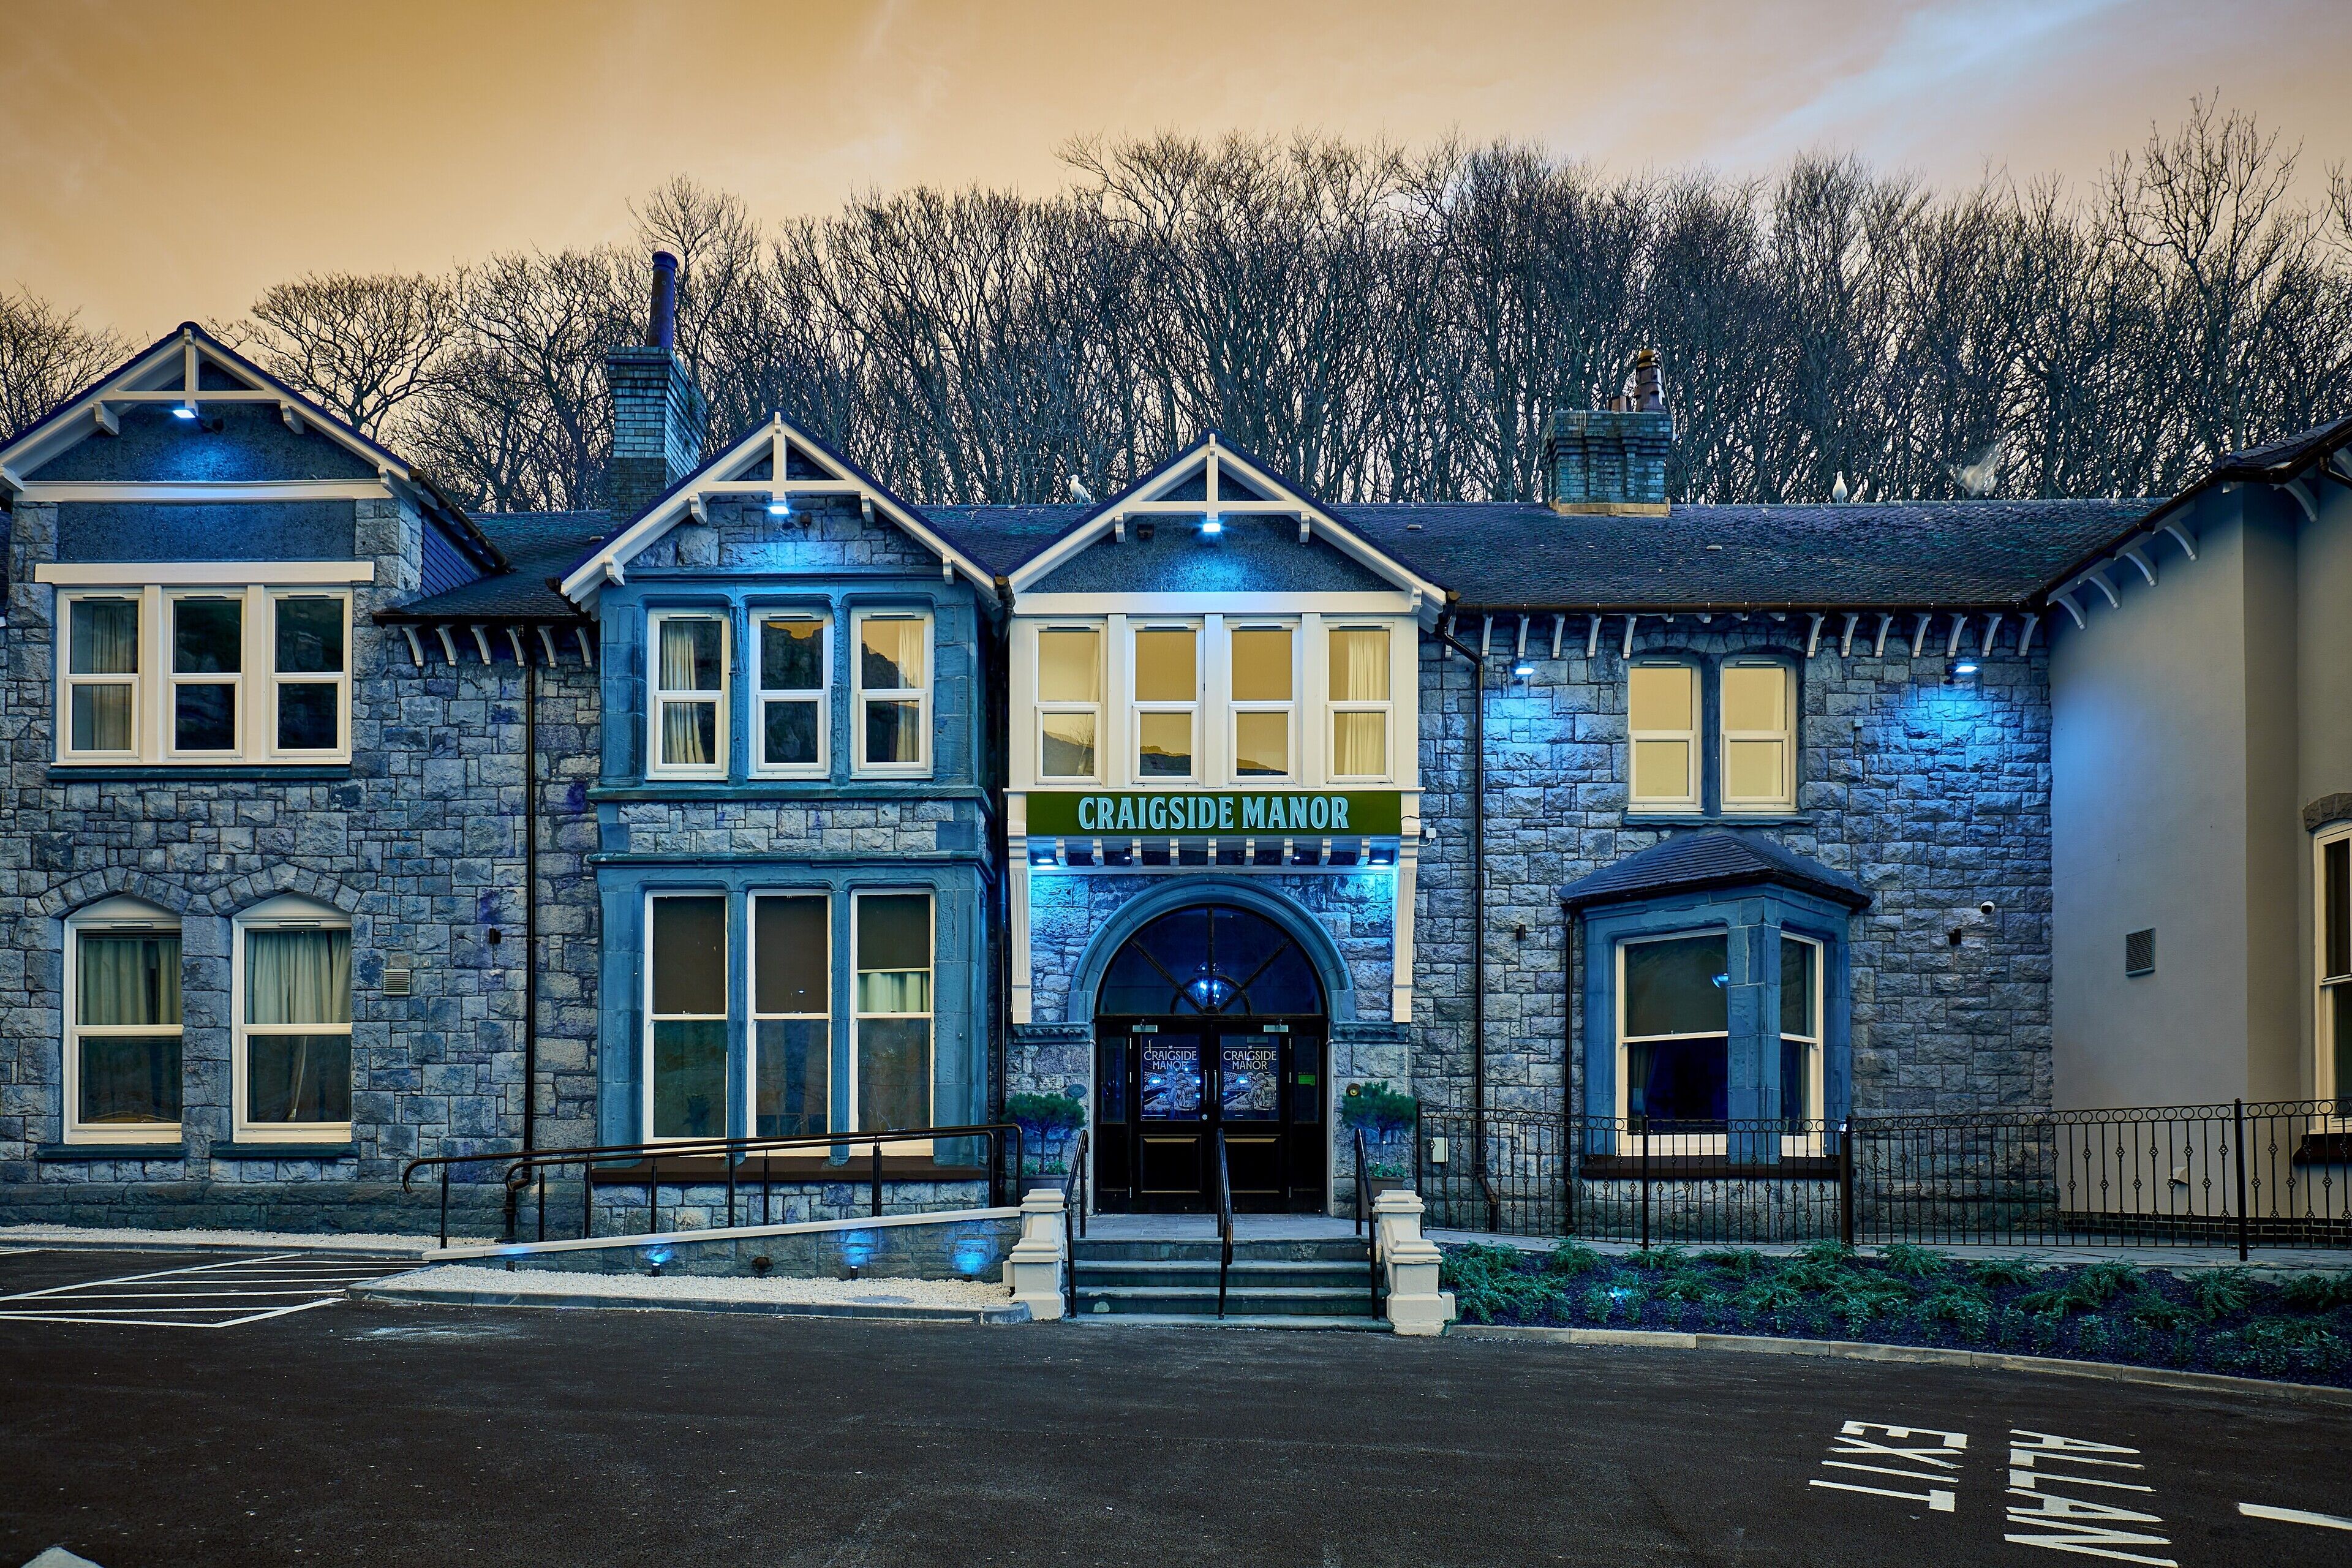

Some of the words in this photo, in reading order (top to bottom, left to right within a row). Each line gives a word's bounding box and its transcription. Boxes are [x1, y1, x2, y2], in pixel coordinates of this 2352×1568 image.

[1078, 797, 1234, 829] CRAIGSIDE
[1242, 797, 1349, 829] MANOR
[1144, 1051, 1197, 1060] CRAIGSIDE
[1223, 1051, 1276, 1060] CRAIGSIDE
[1153, 1061, 1188, 1070] MANOR
[1232, 1061, 1267, 1070] MANOR
[1809, 1420, 1967, 1512] EXIT
[2004, 1428, 2179, 1568] ALLAN
